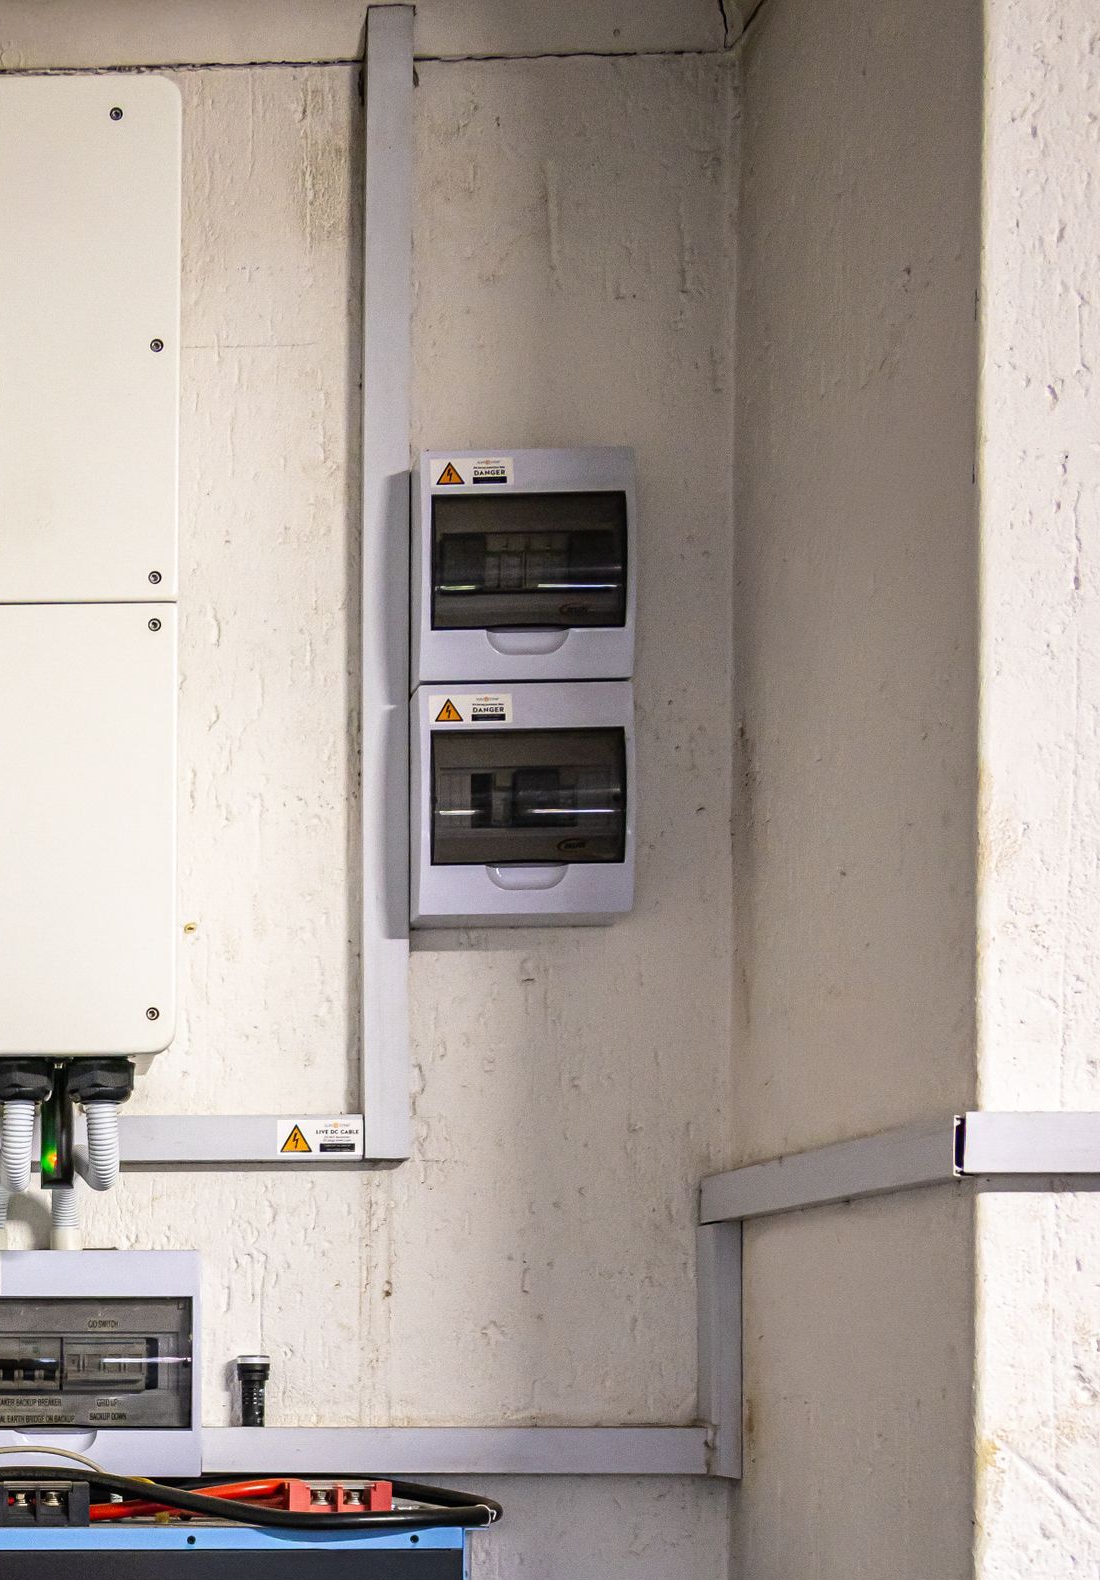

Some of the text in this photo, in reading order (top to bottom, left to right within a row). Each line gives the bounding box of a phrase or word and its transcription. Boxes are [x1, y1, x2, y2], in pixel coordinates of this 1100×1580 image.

[16, 1398, 36, 1406] BACKUP
[38, 1398, 62, 1406] BREAKER
[96, 1398, 109, 1407] GRID
[7, 1415, 24, 1423] EARTH
[26, 1415, 44, 1423] BRIDGE
[45, 1415, 53, 1423] ON
[53, 1414, 75, 1423] BACKUP
[89, 1412, 127, 1420] BACKUP DOWN
